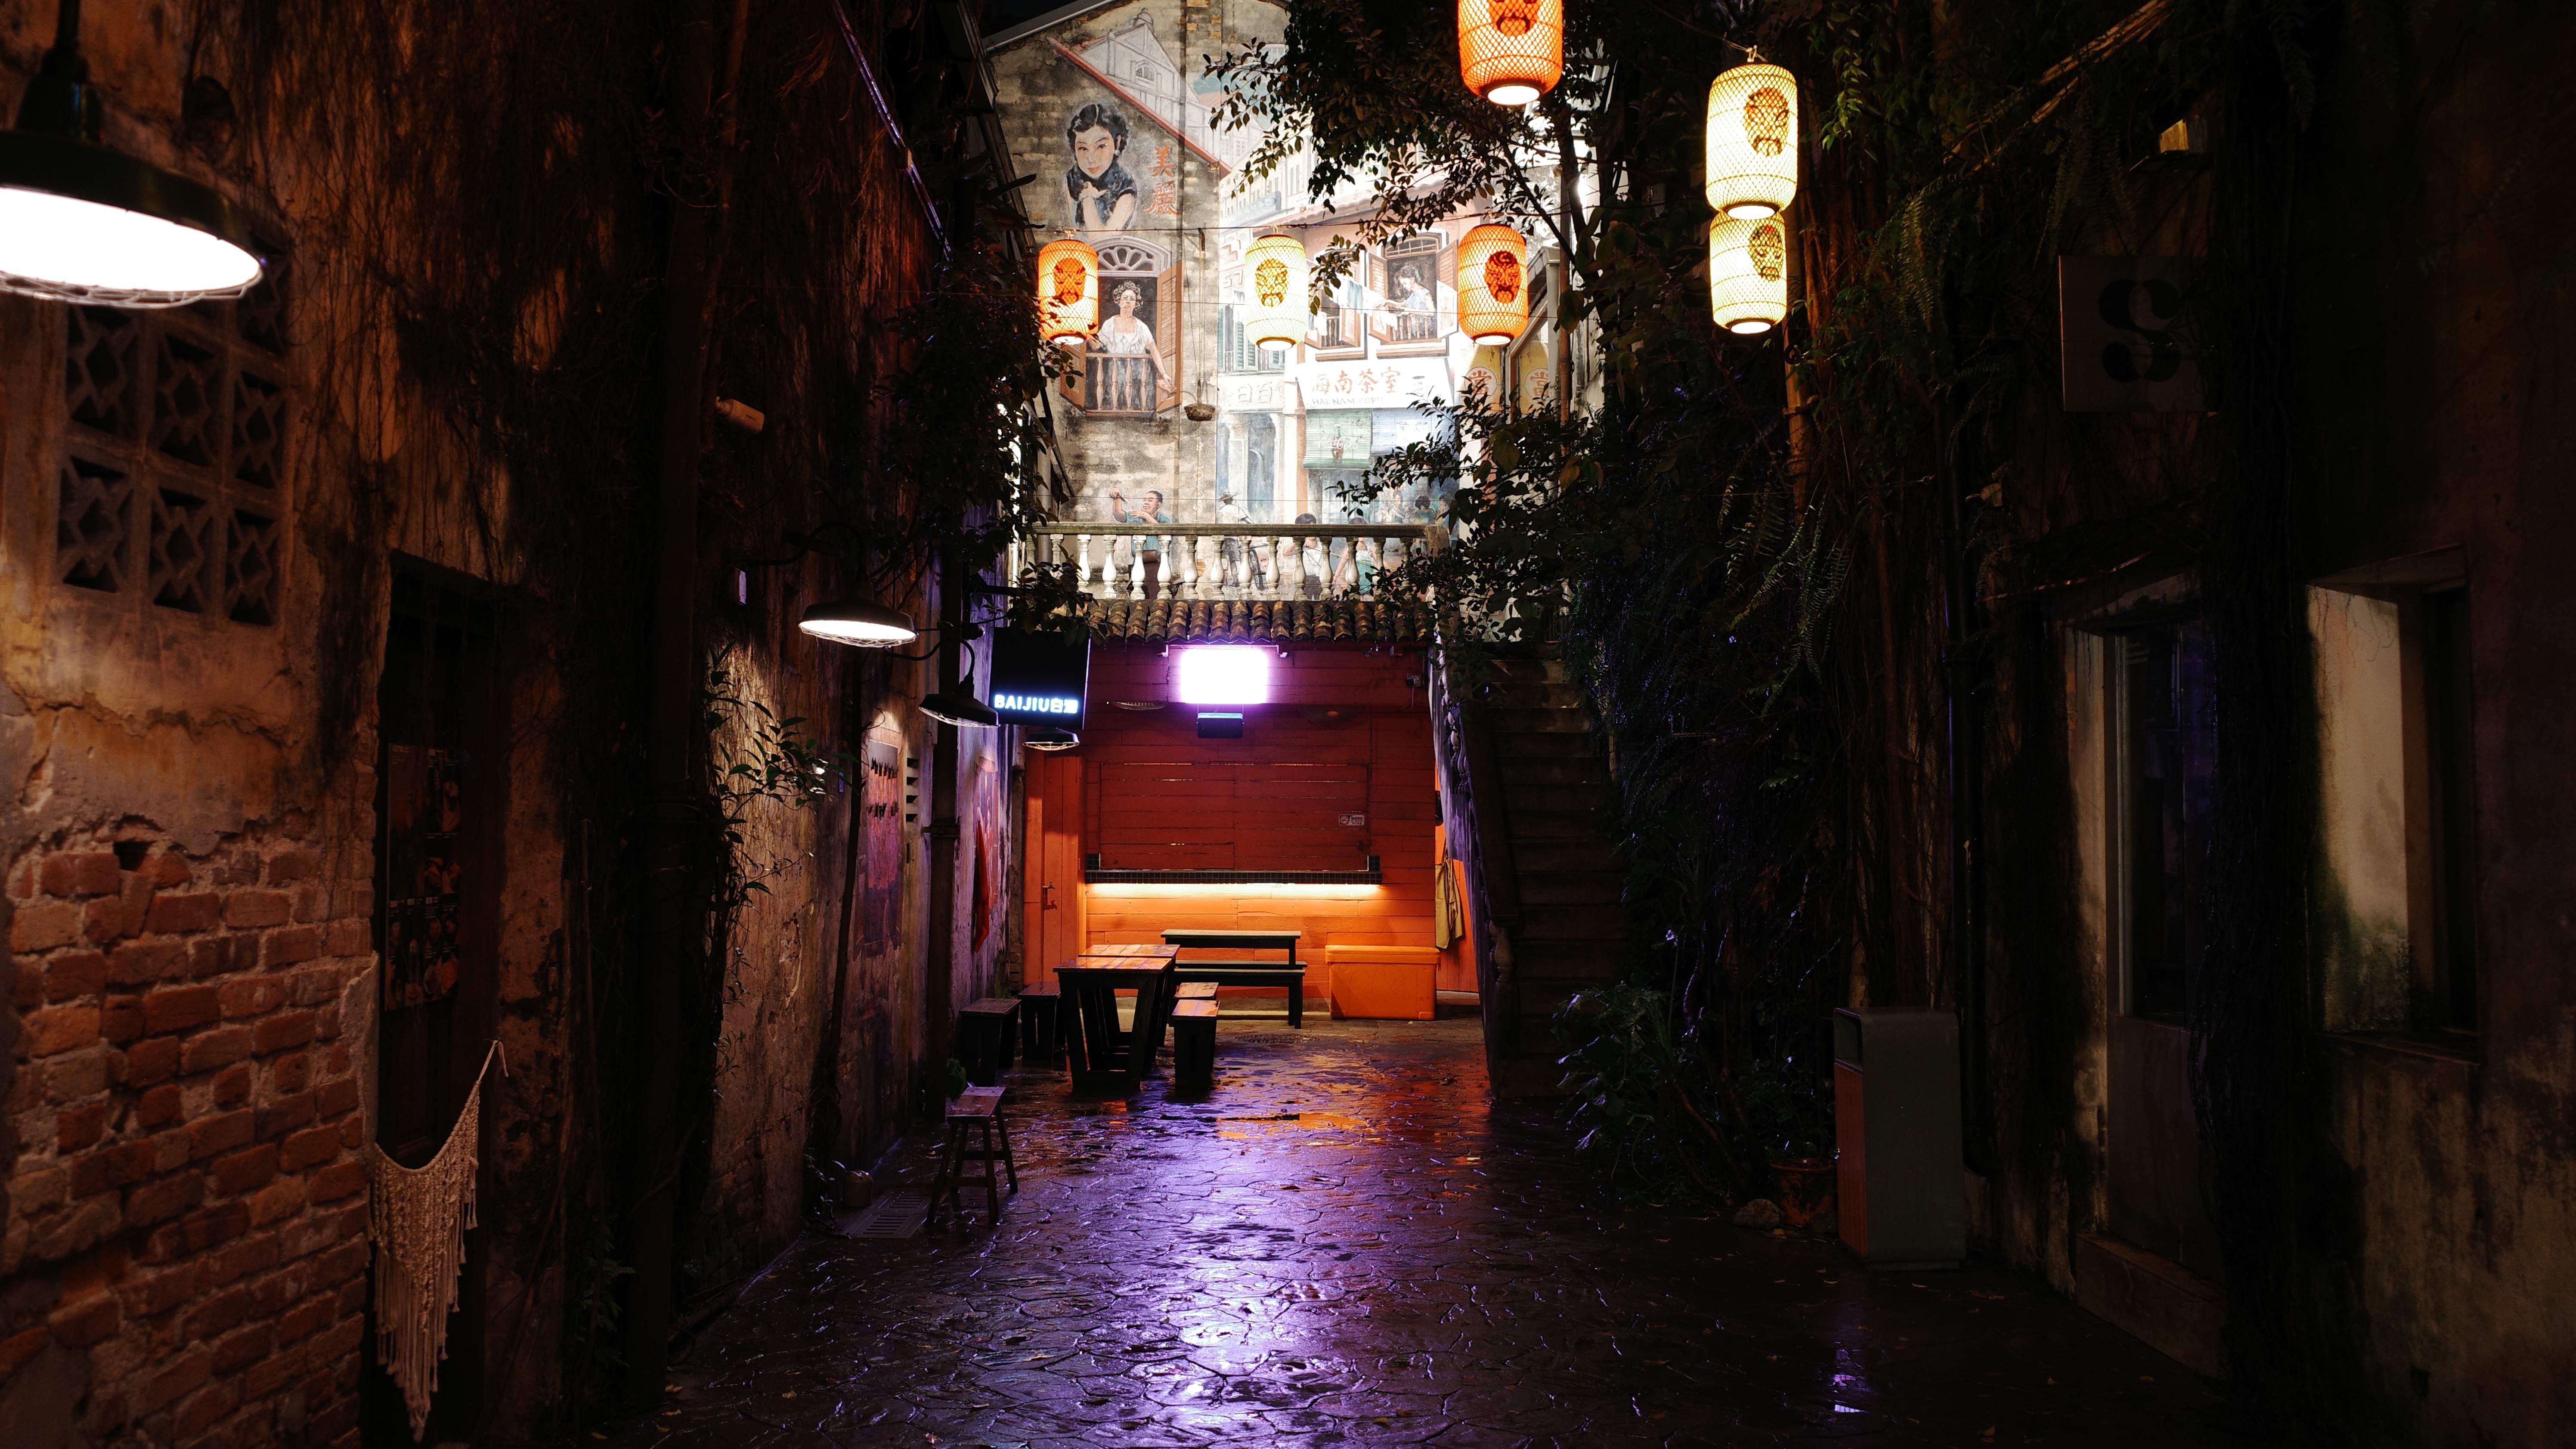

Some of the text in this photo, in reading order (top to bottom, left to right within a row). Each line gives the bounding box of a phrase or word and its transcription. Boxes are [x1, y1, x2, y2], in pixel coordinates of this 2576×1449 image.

[1142, 144, 1183, 216] 美麗
[1311, 366, 1401, 394] 海南茶室
